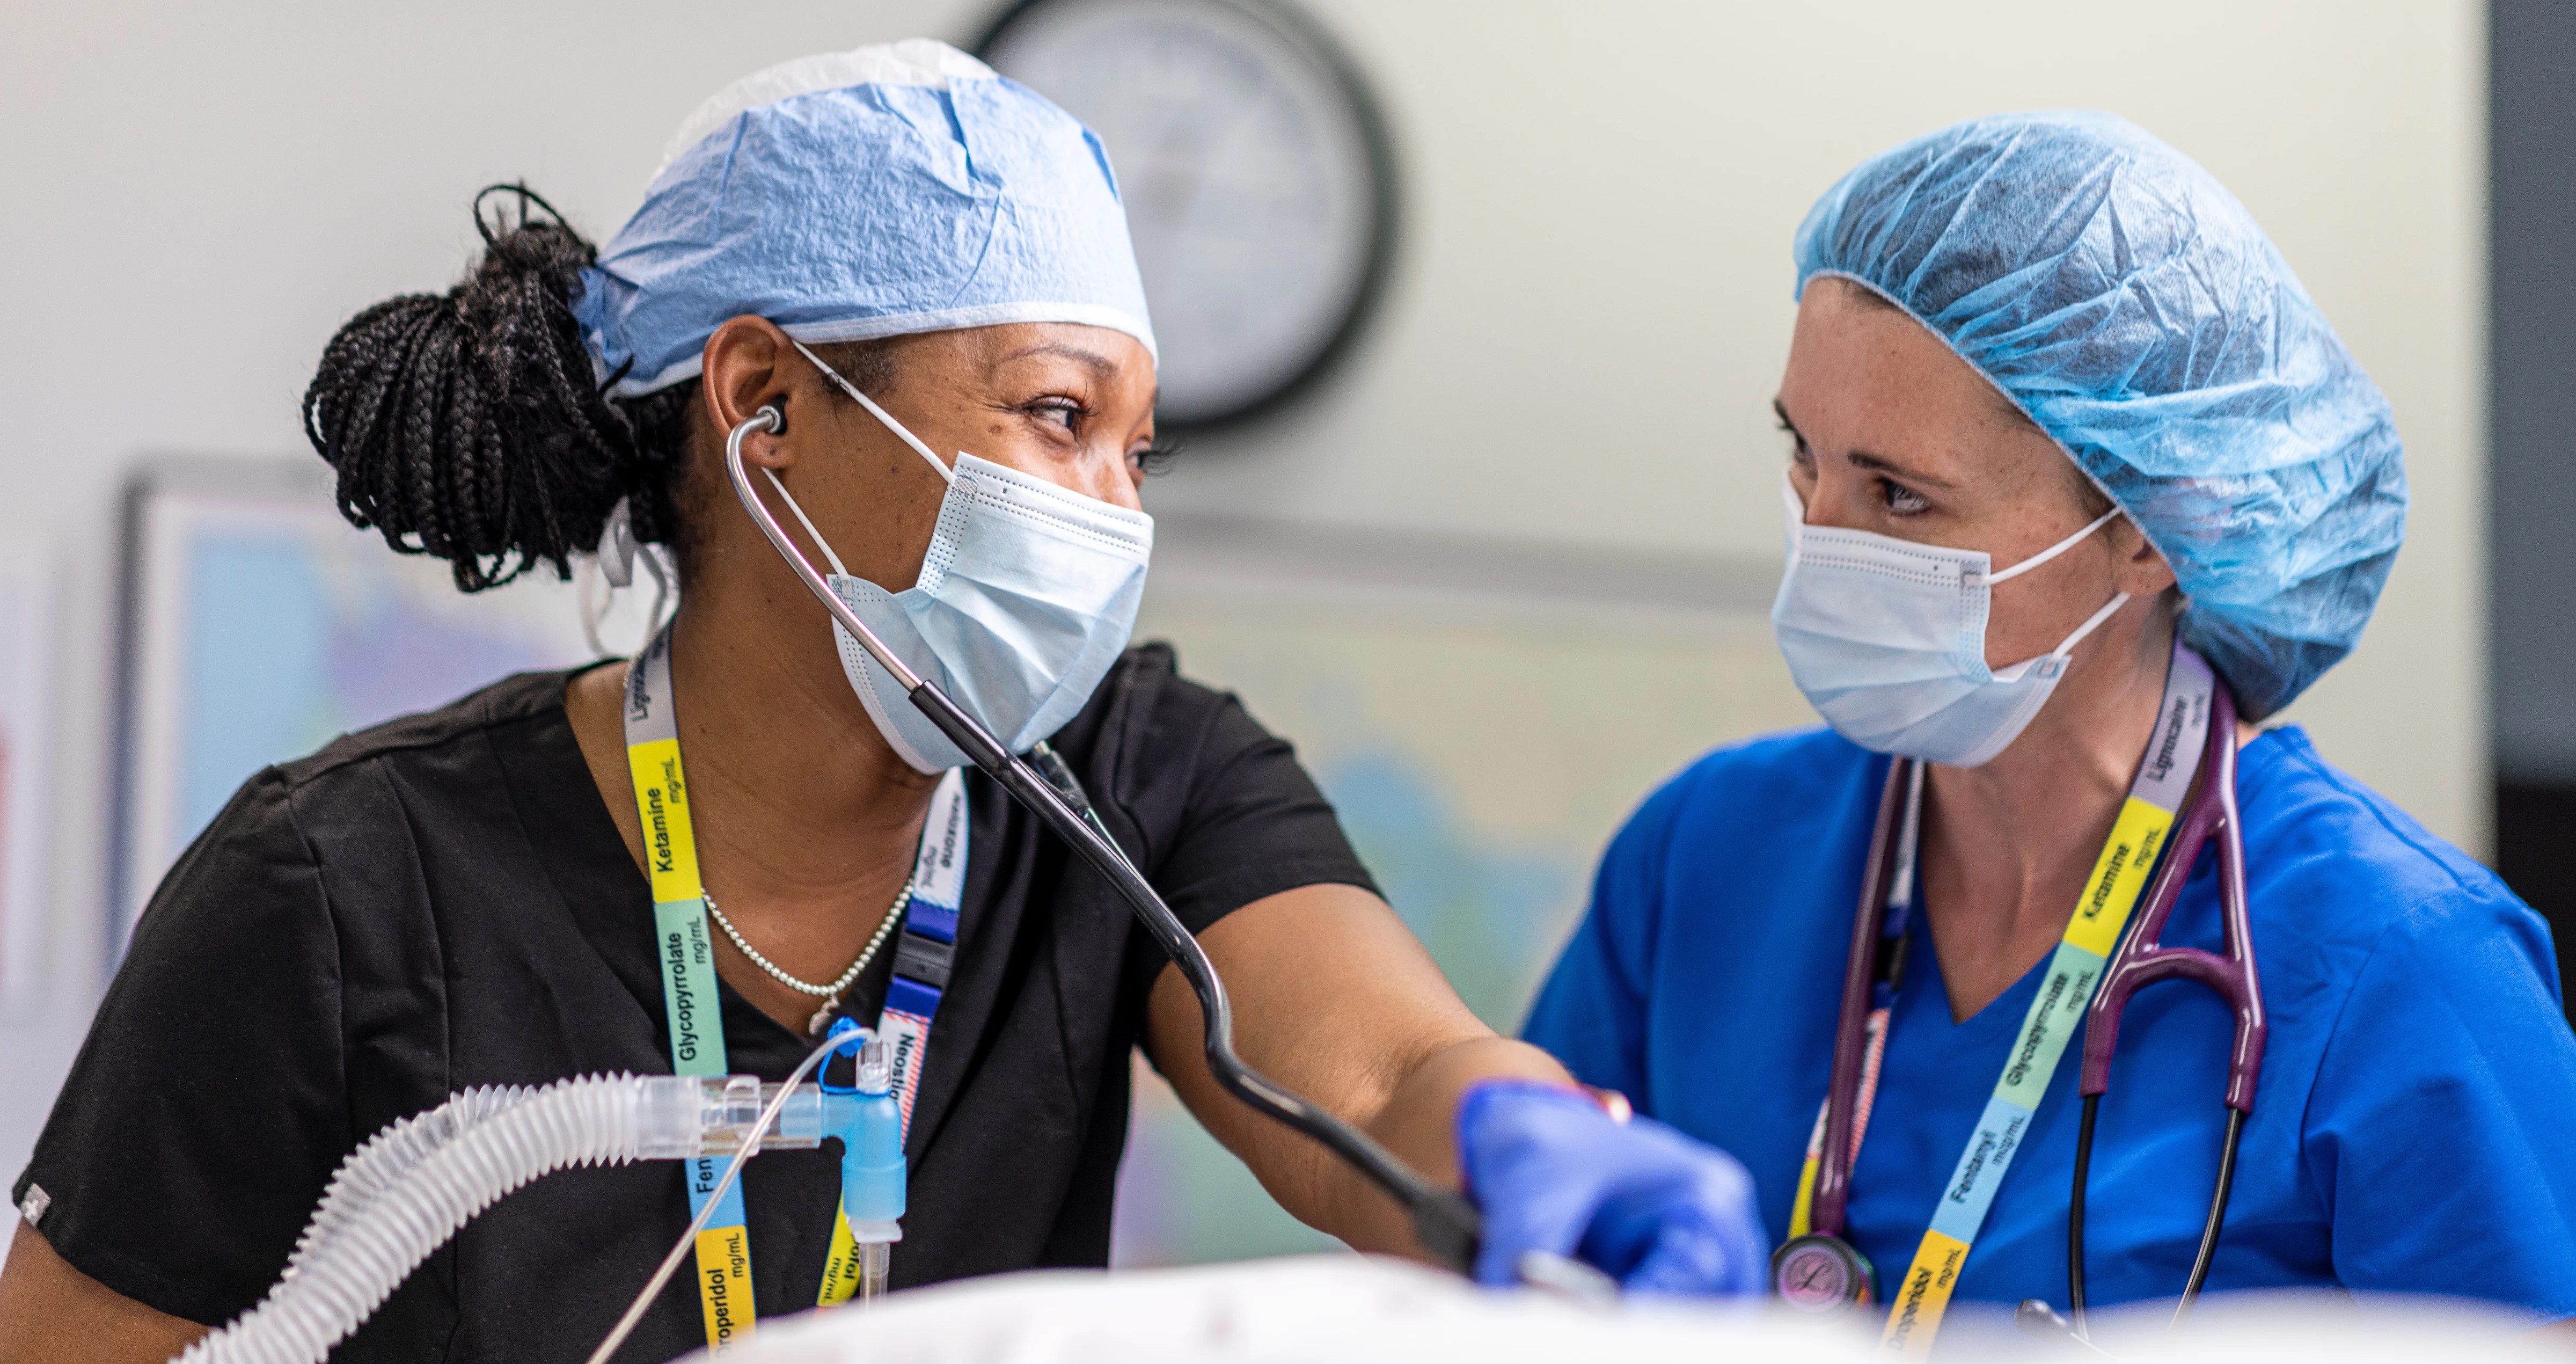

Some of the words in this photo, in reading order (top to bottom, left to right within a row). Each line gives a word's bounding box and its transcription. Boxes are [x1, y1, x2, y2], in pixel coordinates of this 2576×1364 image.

[661, 756, 682, 804] mg/mL
[647, 787, 675, 872] Ketamine
[687, 916, 708, 964] mg/mL
[667, 932, 699, 1061] Glycopyrrolate
[725, 1232, 746, 1278] mg/mL
